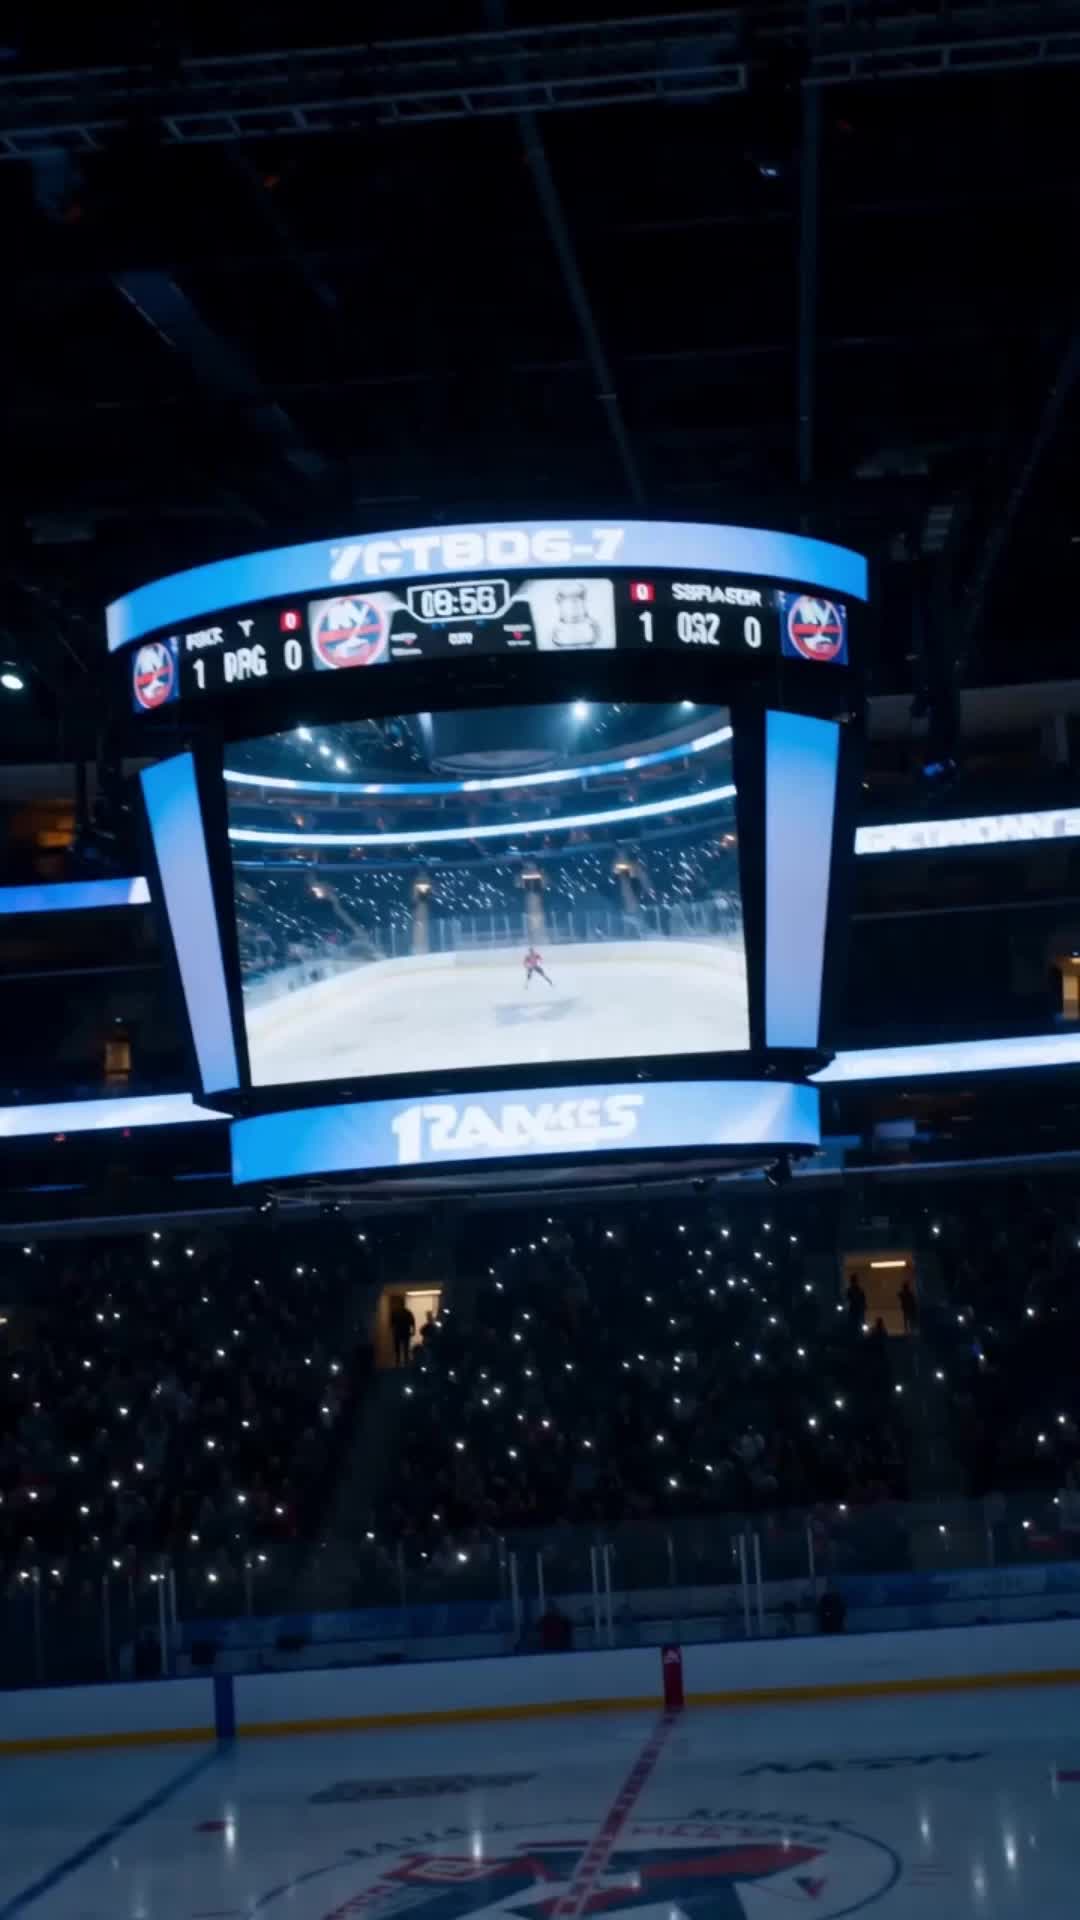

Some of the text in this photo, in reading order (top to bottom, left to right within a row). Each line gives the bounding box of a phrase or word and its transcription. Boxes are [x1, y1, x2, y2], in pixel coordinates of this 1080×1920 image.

[639, 610, 653, 642] 1
[284, 639, 303, 670] 0
[193, 659, 205, 689] 1
